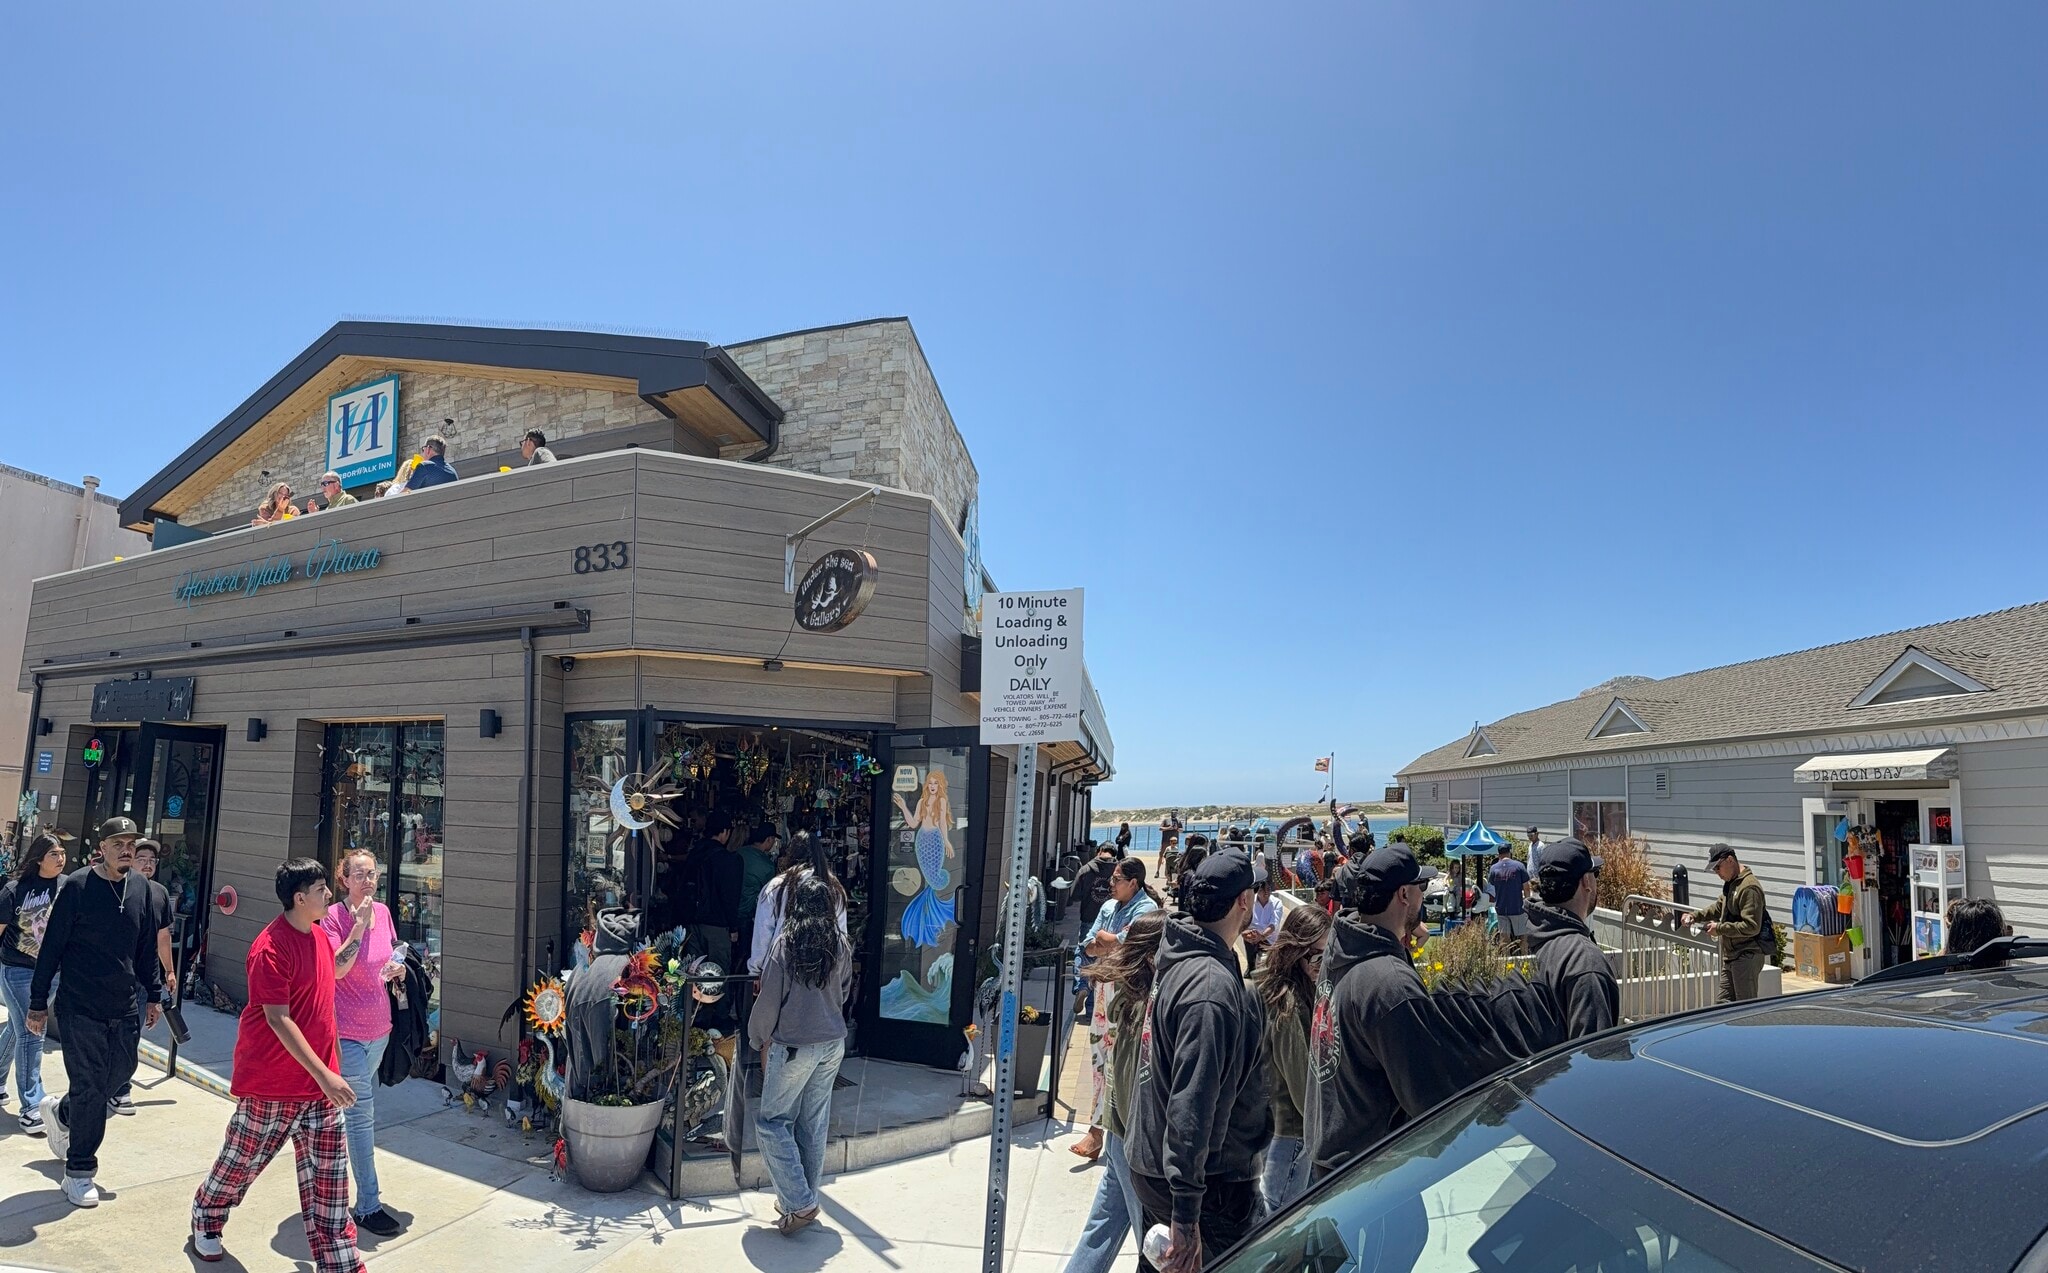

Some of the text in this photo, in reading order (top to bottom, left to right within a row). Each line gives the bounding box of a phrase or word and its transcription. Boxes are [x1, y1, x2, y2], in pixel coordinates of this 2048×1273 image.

[378, 461, 392, 470] INN
[306, 538, 382, 586] Plaza
[574, 541, 628, 574] 833
[998, 595, 1067, 609] 10 Minute
[809, 603, 841, 627] Gallery
[996, 615, 1068, 631] Loading &
[995, 634, 1068, 650] Unloading
[1014, 654, 1048, 670] Only
[1010, 678, 1052, 692] DAILY
[1813, 766, 1903, 781] DRAGON BAY
[121, 819, 130, 830] P
[1936, 816, 1952, 828] OP
